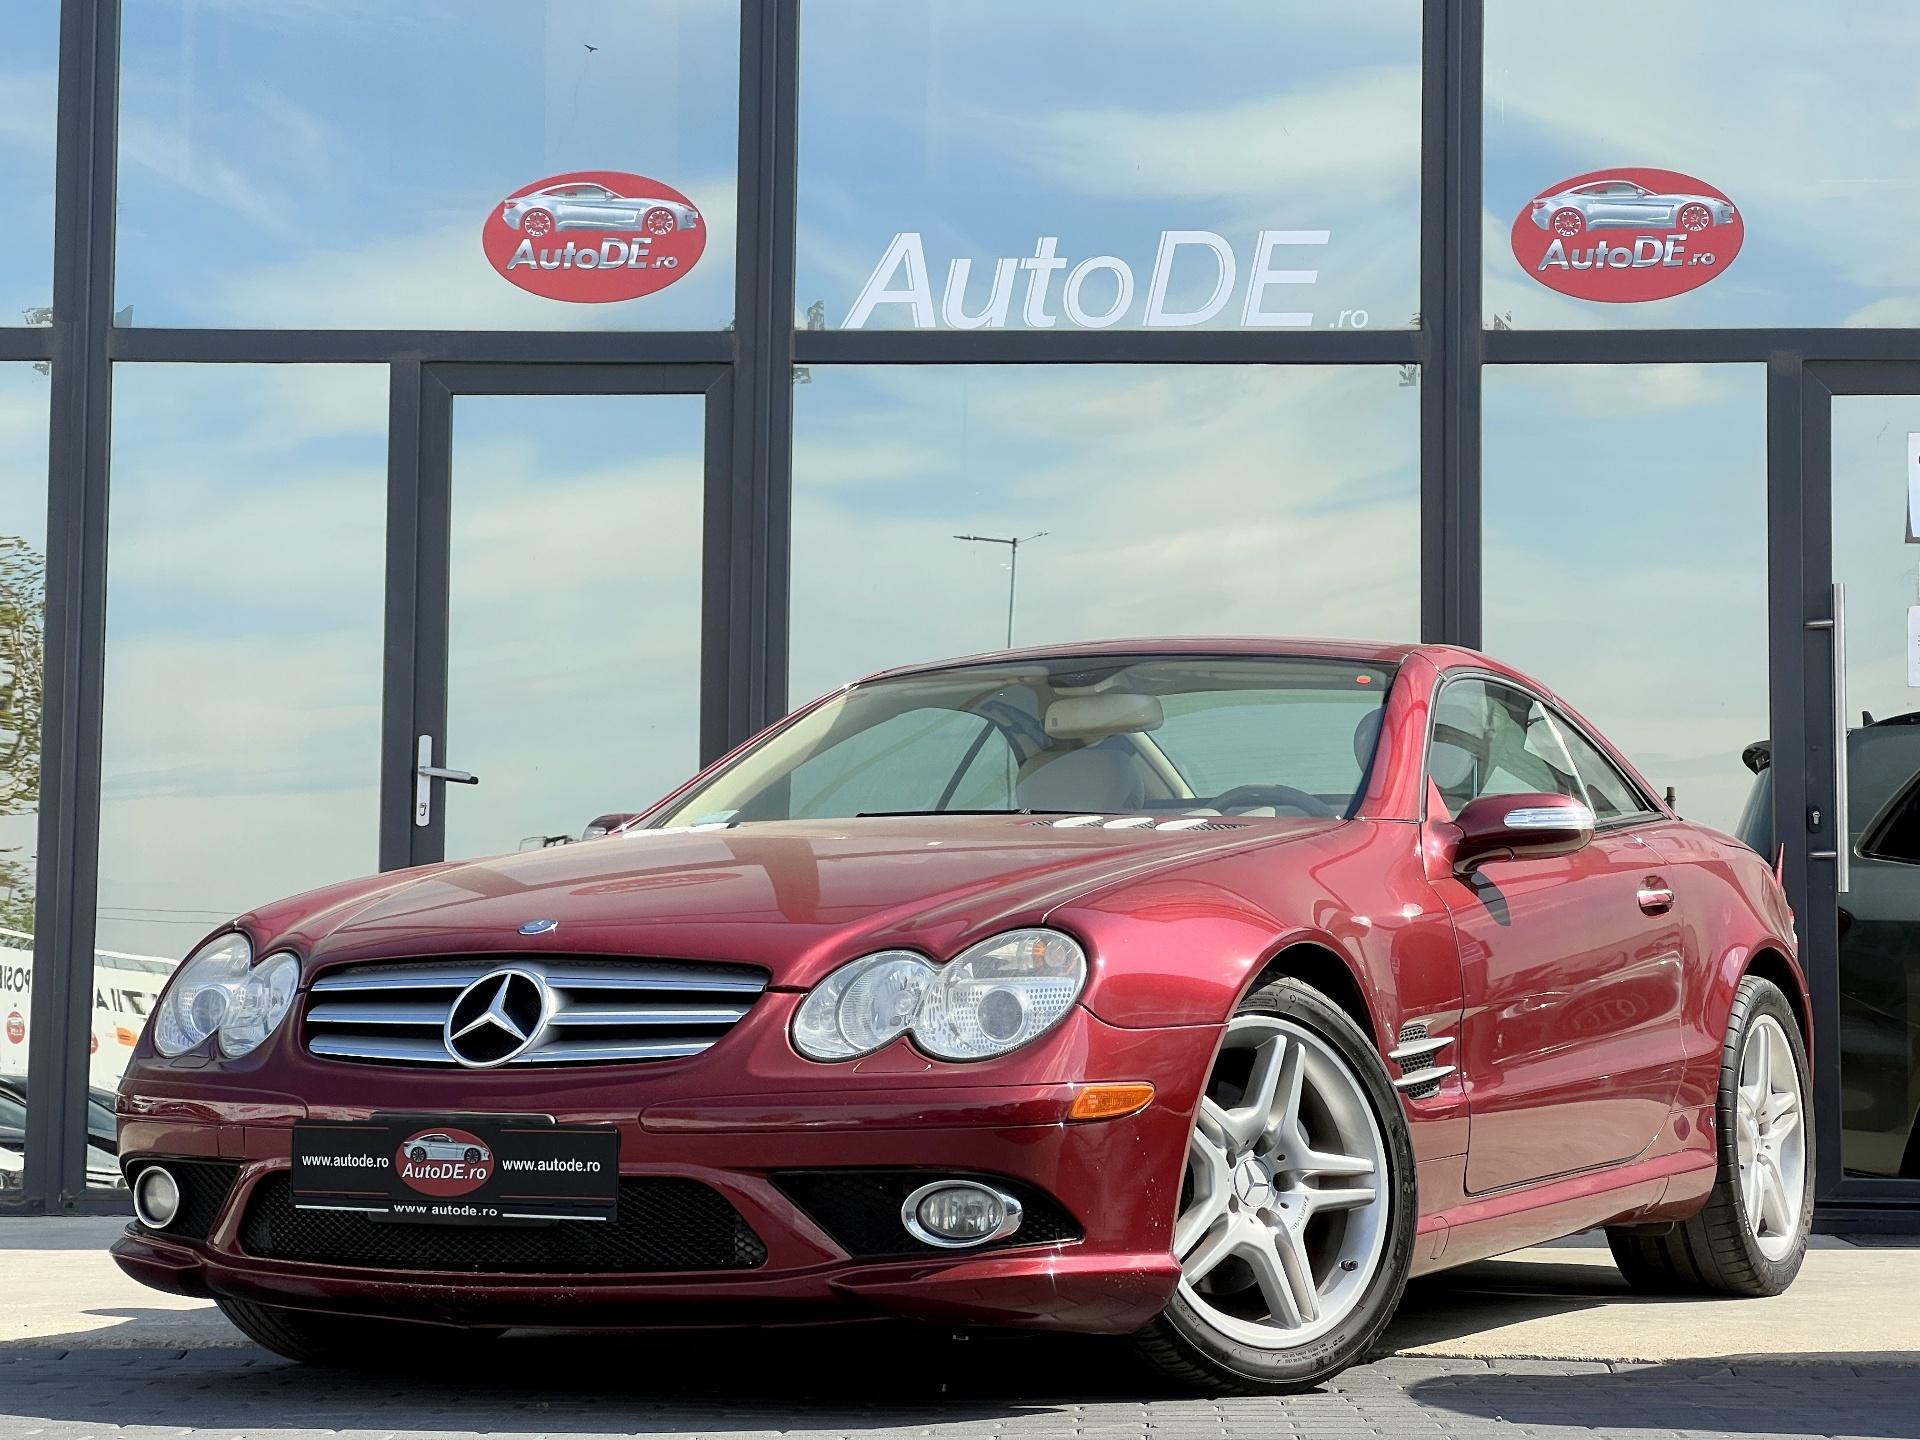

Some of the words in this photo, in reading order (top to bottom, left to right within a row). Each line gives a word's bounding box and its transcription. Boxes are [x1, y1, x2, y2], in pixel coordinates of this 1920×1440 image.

[506, 237, 652, 271] AutoDE
[1537, 234, 1687, 271] AutoDE
[840, 230, 1331, 329] AutoDE
[301, 1153, 389, 1168] www.autode.ro
[401, 1162, 487, 1180] AutoDE.ro
[502, 1158, 601, 1172] www.autode.ro
